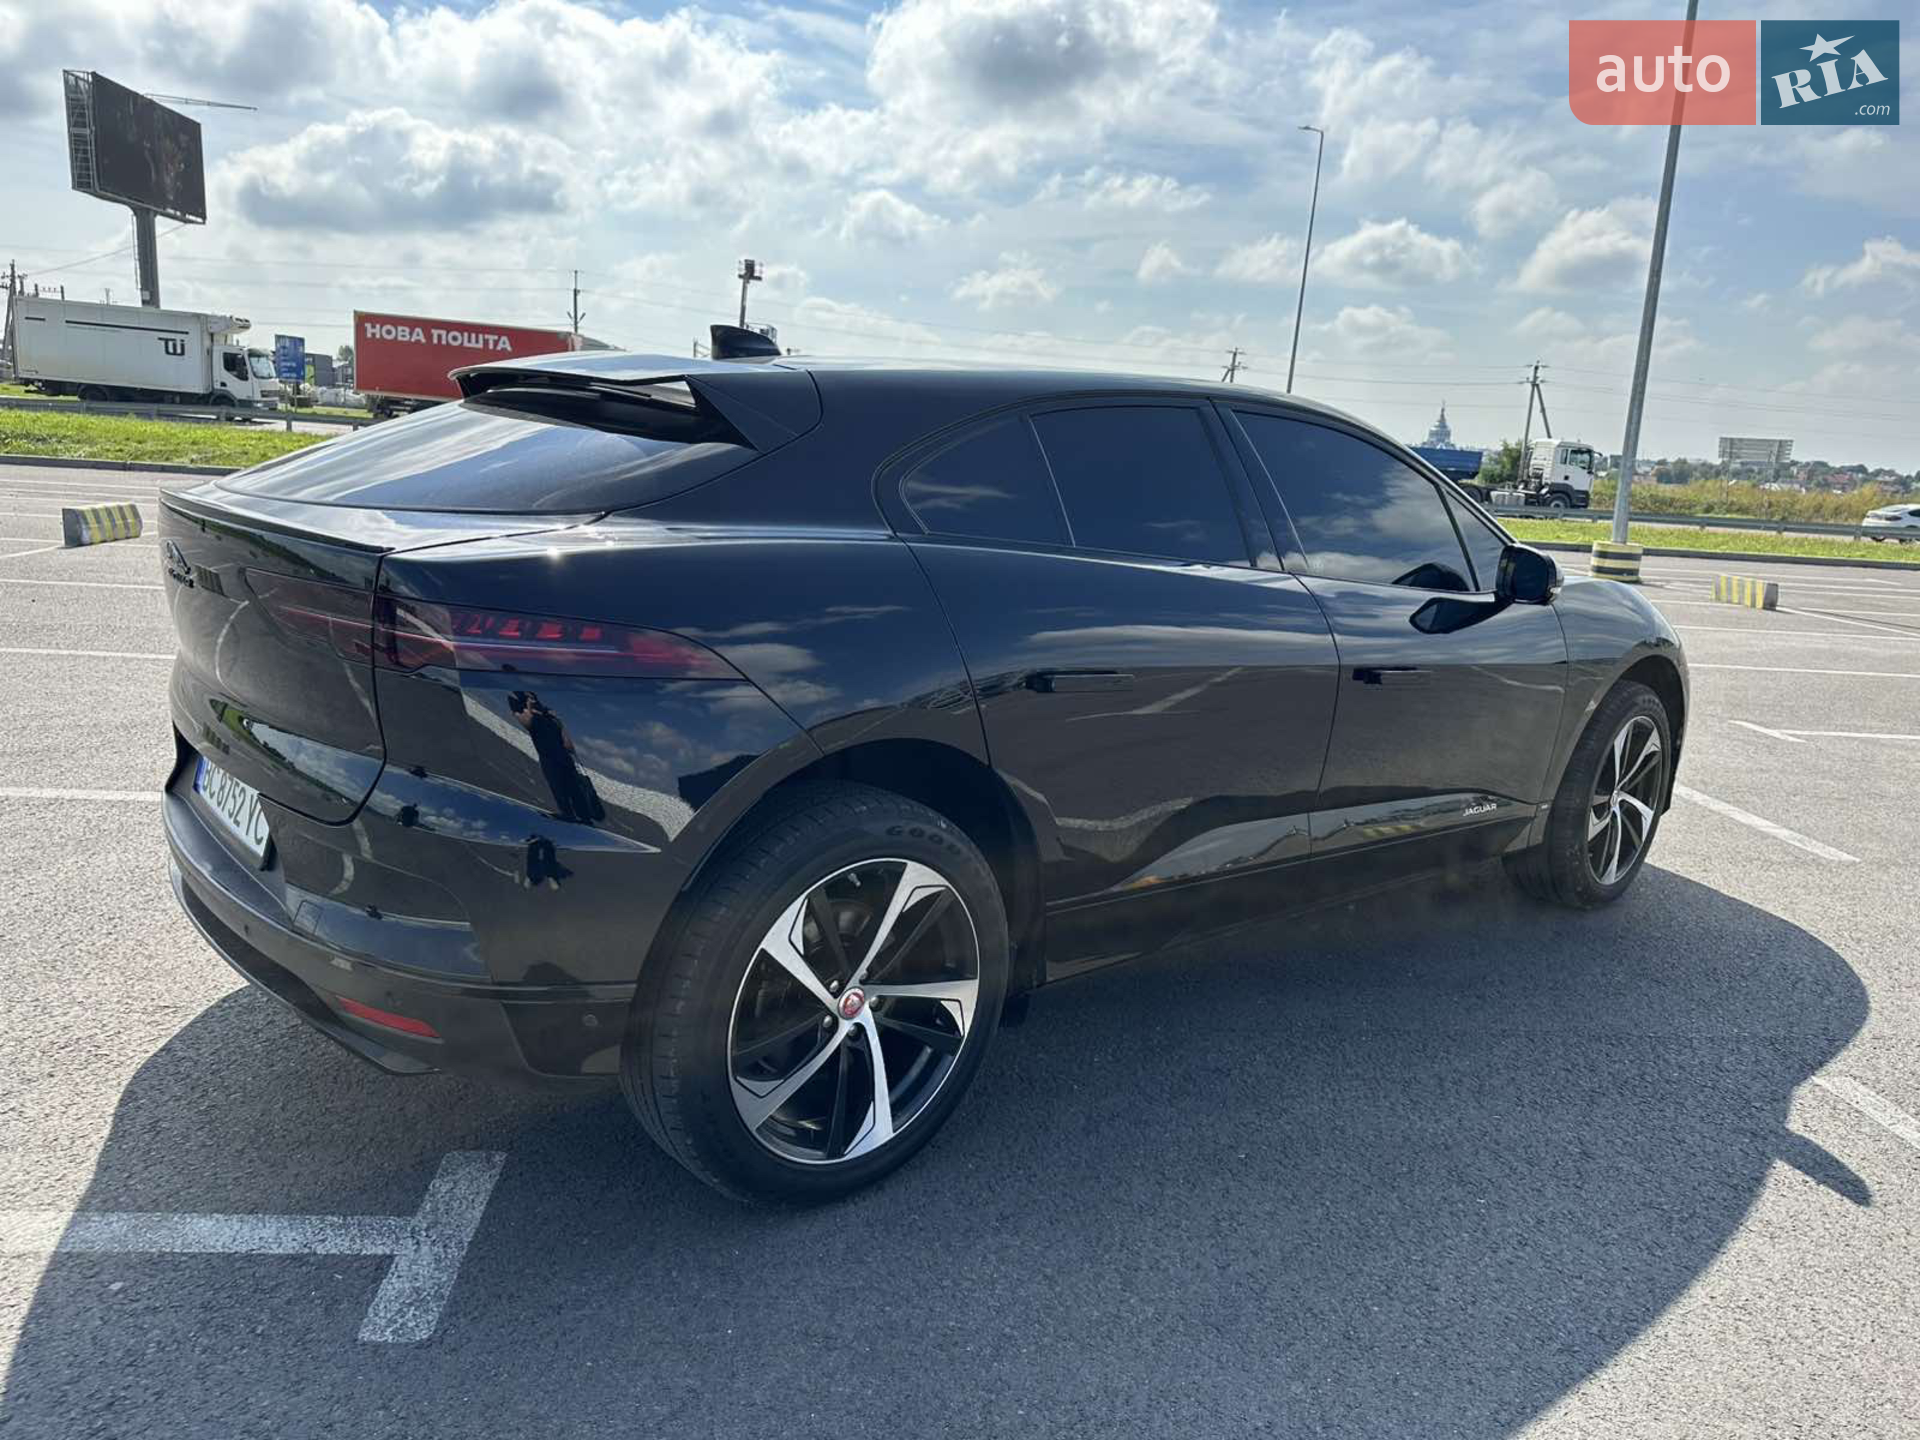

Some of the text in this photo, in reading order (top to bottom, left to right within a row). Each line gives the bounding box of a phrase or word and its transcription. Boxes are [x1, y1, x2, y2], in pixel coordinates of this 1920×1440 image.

[364, 322, 513, 352] НОВА ПОШТА
[1462, 803, 1498, 817] JAGUAR
